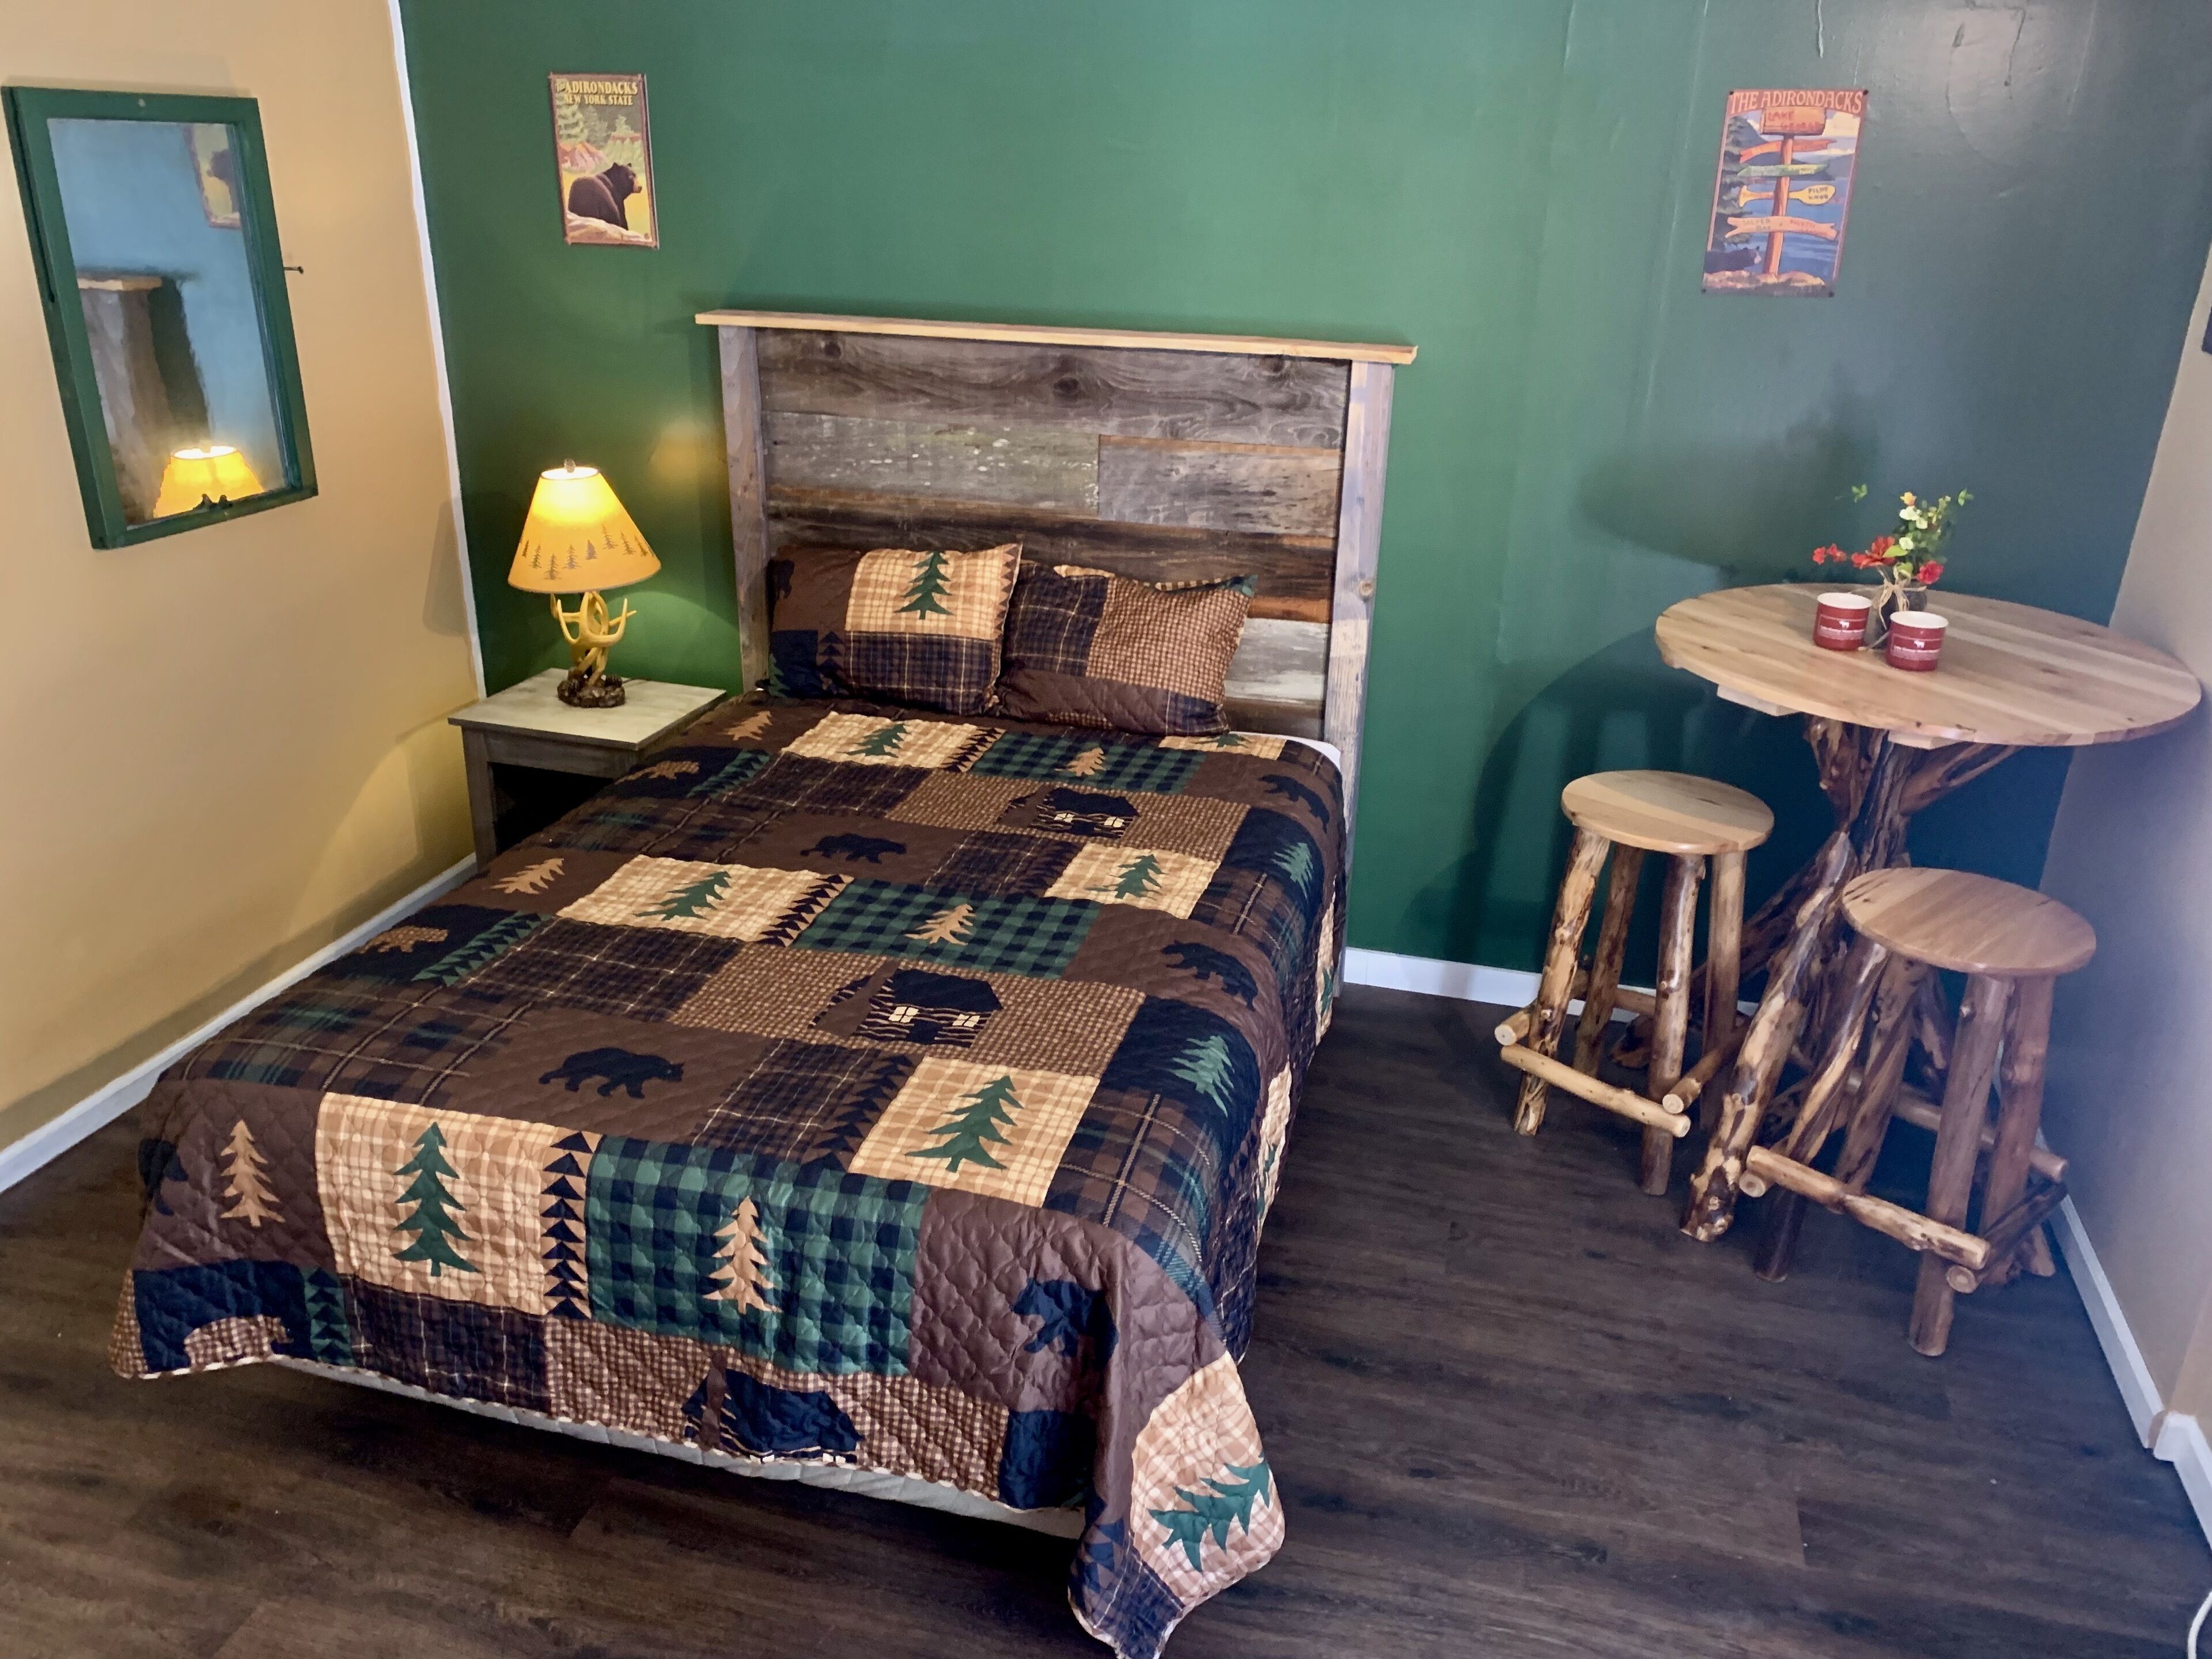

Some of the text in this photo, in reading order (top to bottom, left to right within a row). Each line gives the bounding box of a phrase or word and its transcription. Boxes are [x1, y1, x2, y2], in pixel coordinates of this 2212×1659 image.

[566, 81, 638, 95] ADIRONDACKS
[564, 94, 633, 105] NEW YORK STATE
[1730, 90, 1863, 114] THE ADIRONDACKS
